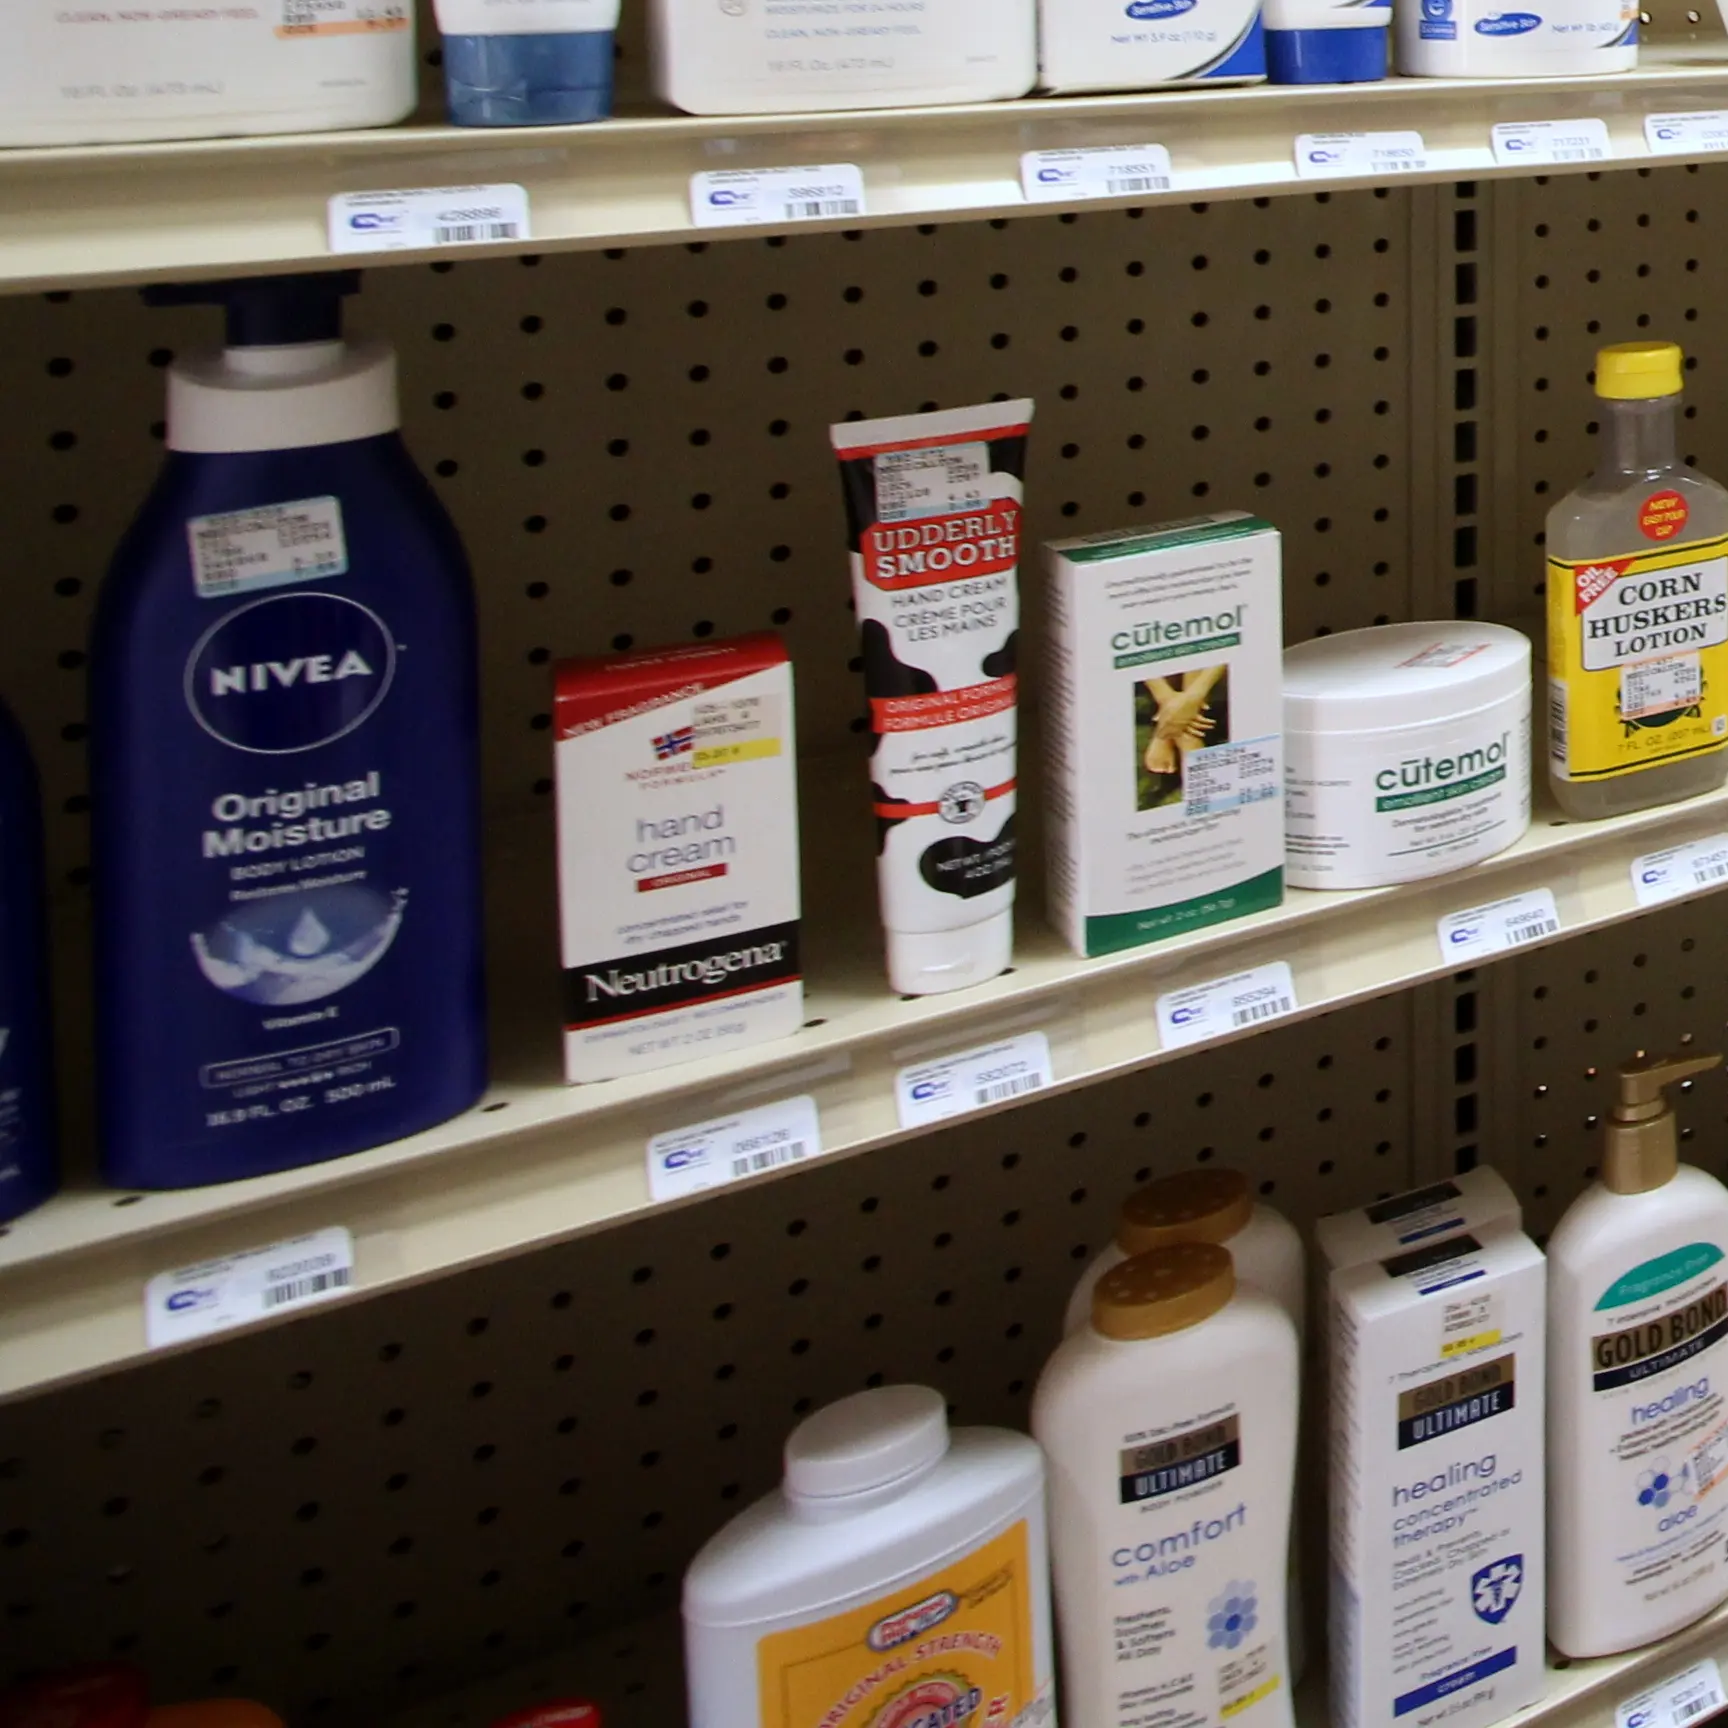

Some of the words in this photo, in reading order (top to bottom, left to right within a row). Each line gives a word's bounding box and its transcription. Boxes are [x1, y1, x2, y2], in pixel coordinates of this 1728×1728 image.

[873, 510, 1017, 554] UDDERLY
[875, 536, 1016, 580] SMOOTH
[1575, 563, 1605, 593] OIL
[891, 588, 942, 610] HAND
[945, 576, 1008, 603] CREAM
[958, 597, 1008, 620] POUR
[1578, 569, 1619, 605] FREE
[1617, 572, 1702, 606] CORN
[1588, 593, 1728, 640] HUSKERS
[1613, 622, 1708, 659] LOTION
[210, 649, 372, 697] NIVEA
[211, 772, 381, 825] Original
[202, 804, 391, 859] Moisture
[634, 803, 724, 844] hand
[626, 832, 736, 875] cream
[586, 941, 784, 1005] Neutrogena
[1598, 1318, 1666, 1369] GOLD
[1411, 1389, 1502, 1442] ULTIMATE
[1631, 1376, 1710, 1427] healing
[1135, 1451, 1229, 1498] ULTIMATE
[1392, 1454, 1498, 1508] healing
[1393, 1469, 1523, 1533] concentrated
[1658, 1503, 1698, 1533] aloe
[1112, 1504, 1248, 1568] comfort
[1393, 1508, 1470, 1551] therapy
[1146, 1552, 1197, 1579] Aloe
